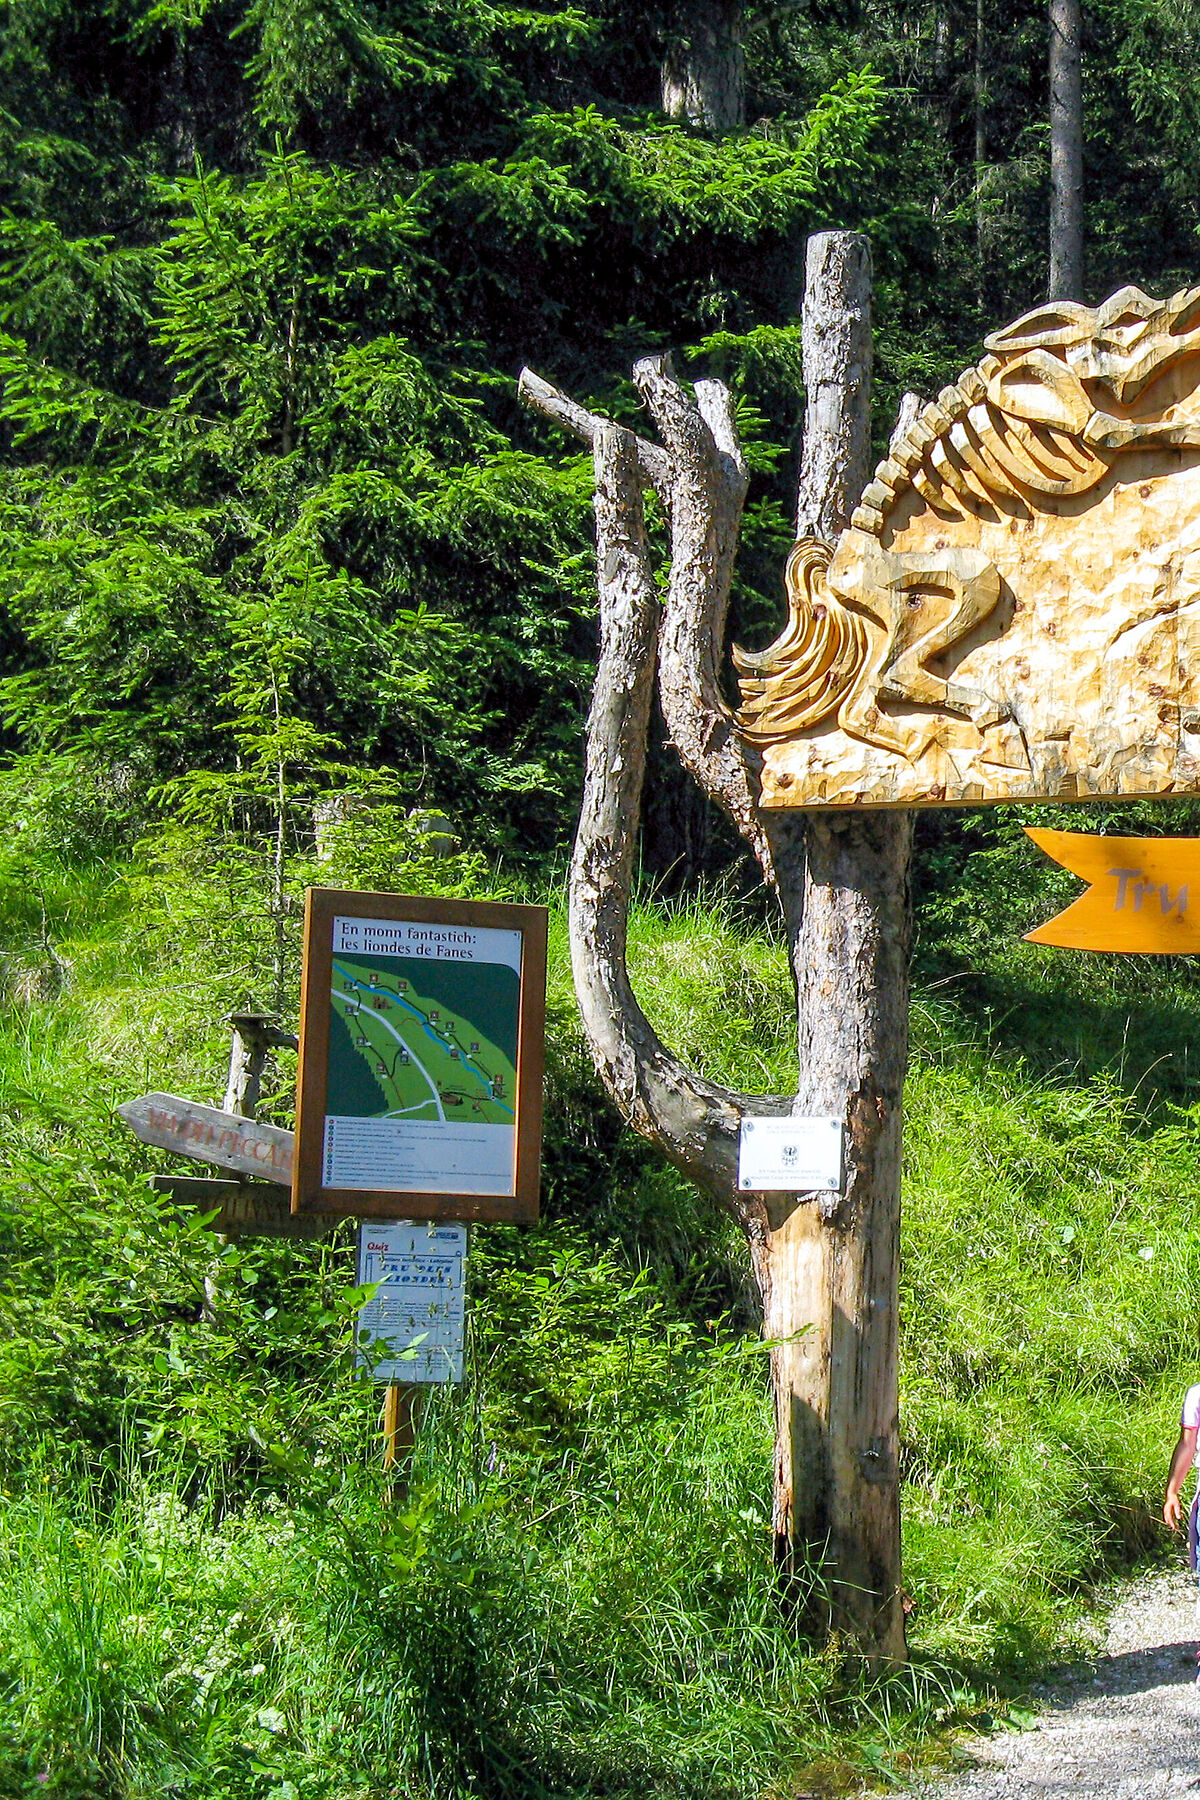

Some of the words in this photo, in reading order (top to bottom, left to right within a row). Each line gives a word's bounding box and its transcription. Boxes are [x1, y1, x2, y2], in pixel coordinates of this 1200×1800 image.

[1105, 867, 1189, 915] Tru
[342, 922, 359, 935] En
[364, 926, 402, 939] monn
[408, 927, 477, 944] fantastich:
[341, 937, 358, 951] les
[364, 939, 411, 955] liondes
[416, 943, 432, 957] de
[437, 944, 473, 959] Fanes
[367, 1241, 390, 1251] Quiz
